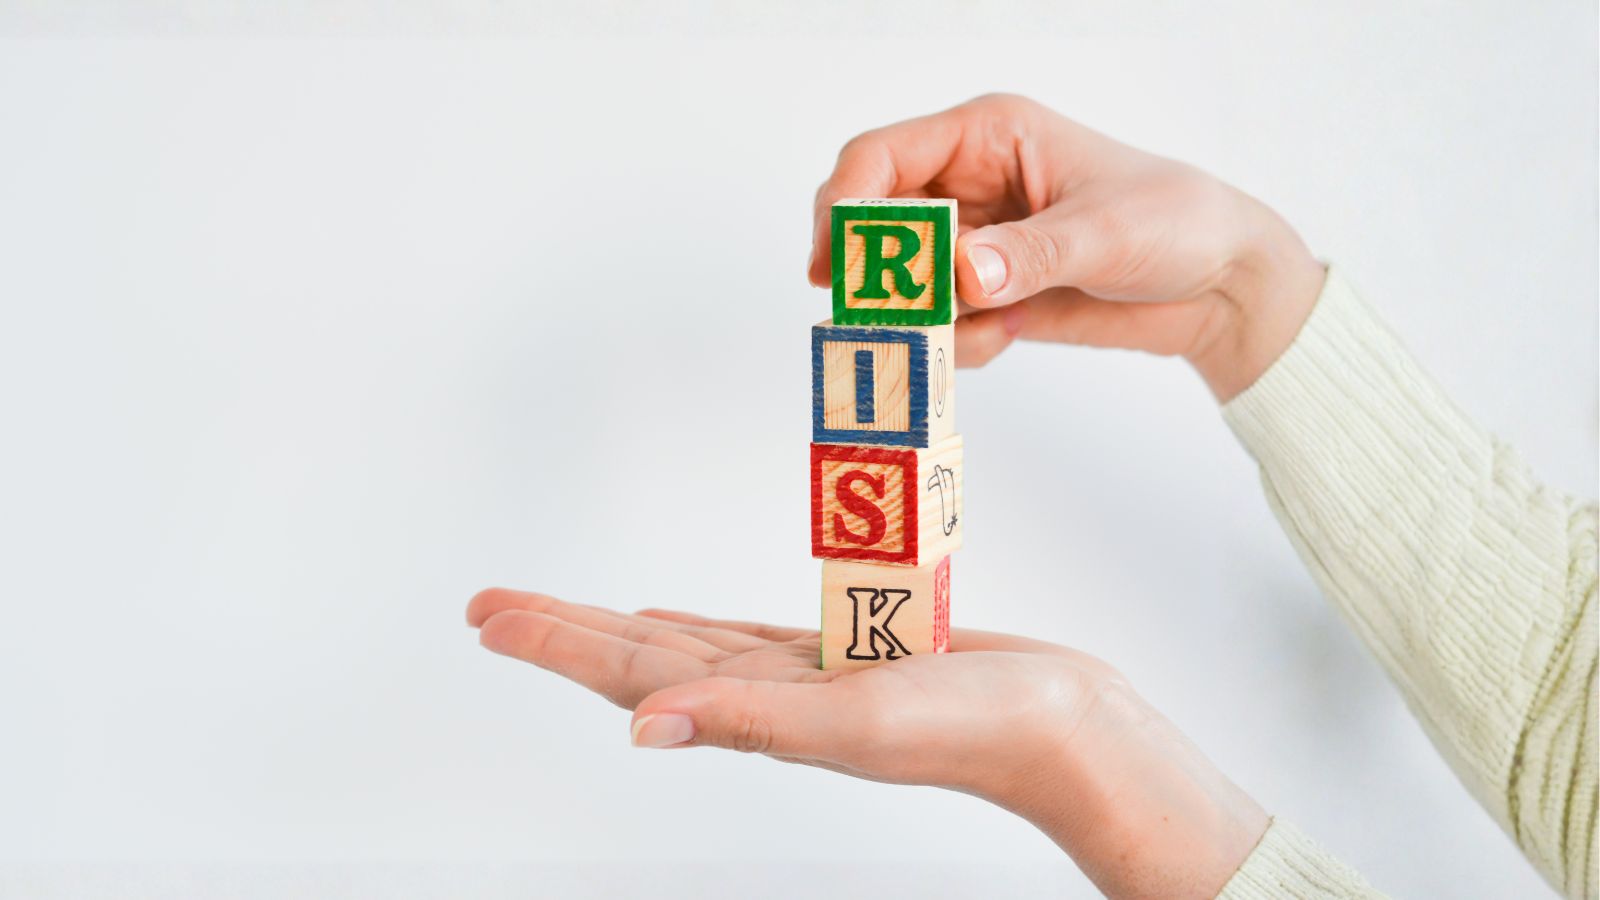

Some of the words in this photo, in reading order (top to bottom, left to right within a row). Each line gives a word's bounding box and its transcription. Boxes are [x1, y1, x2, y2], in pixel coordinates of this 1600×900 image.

[852, 225, 926, 300] R
[834, 469, 887, 547] S
[846, 587, 912, 661] K
